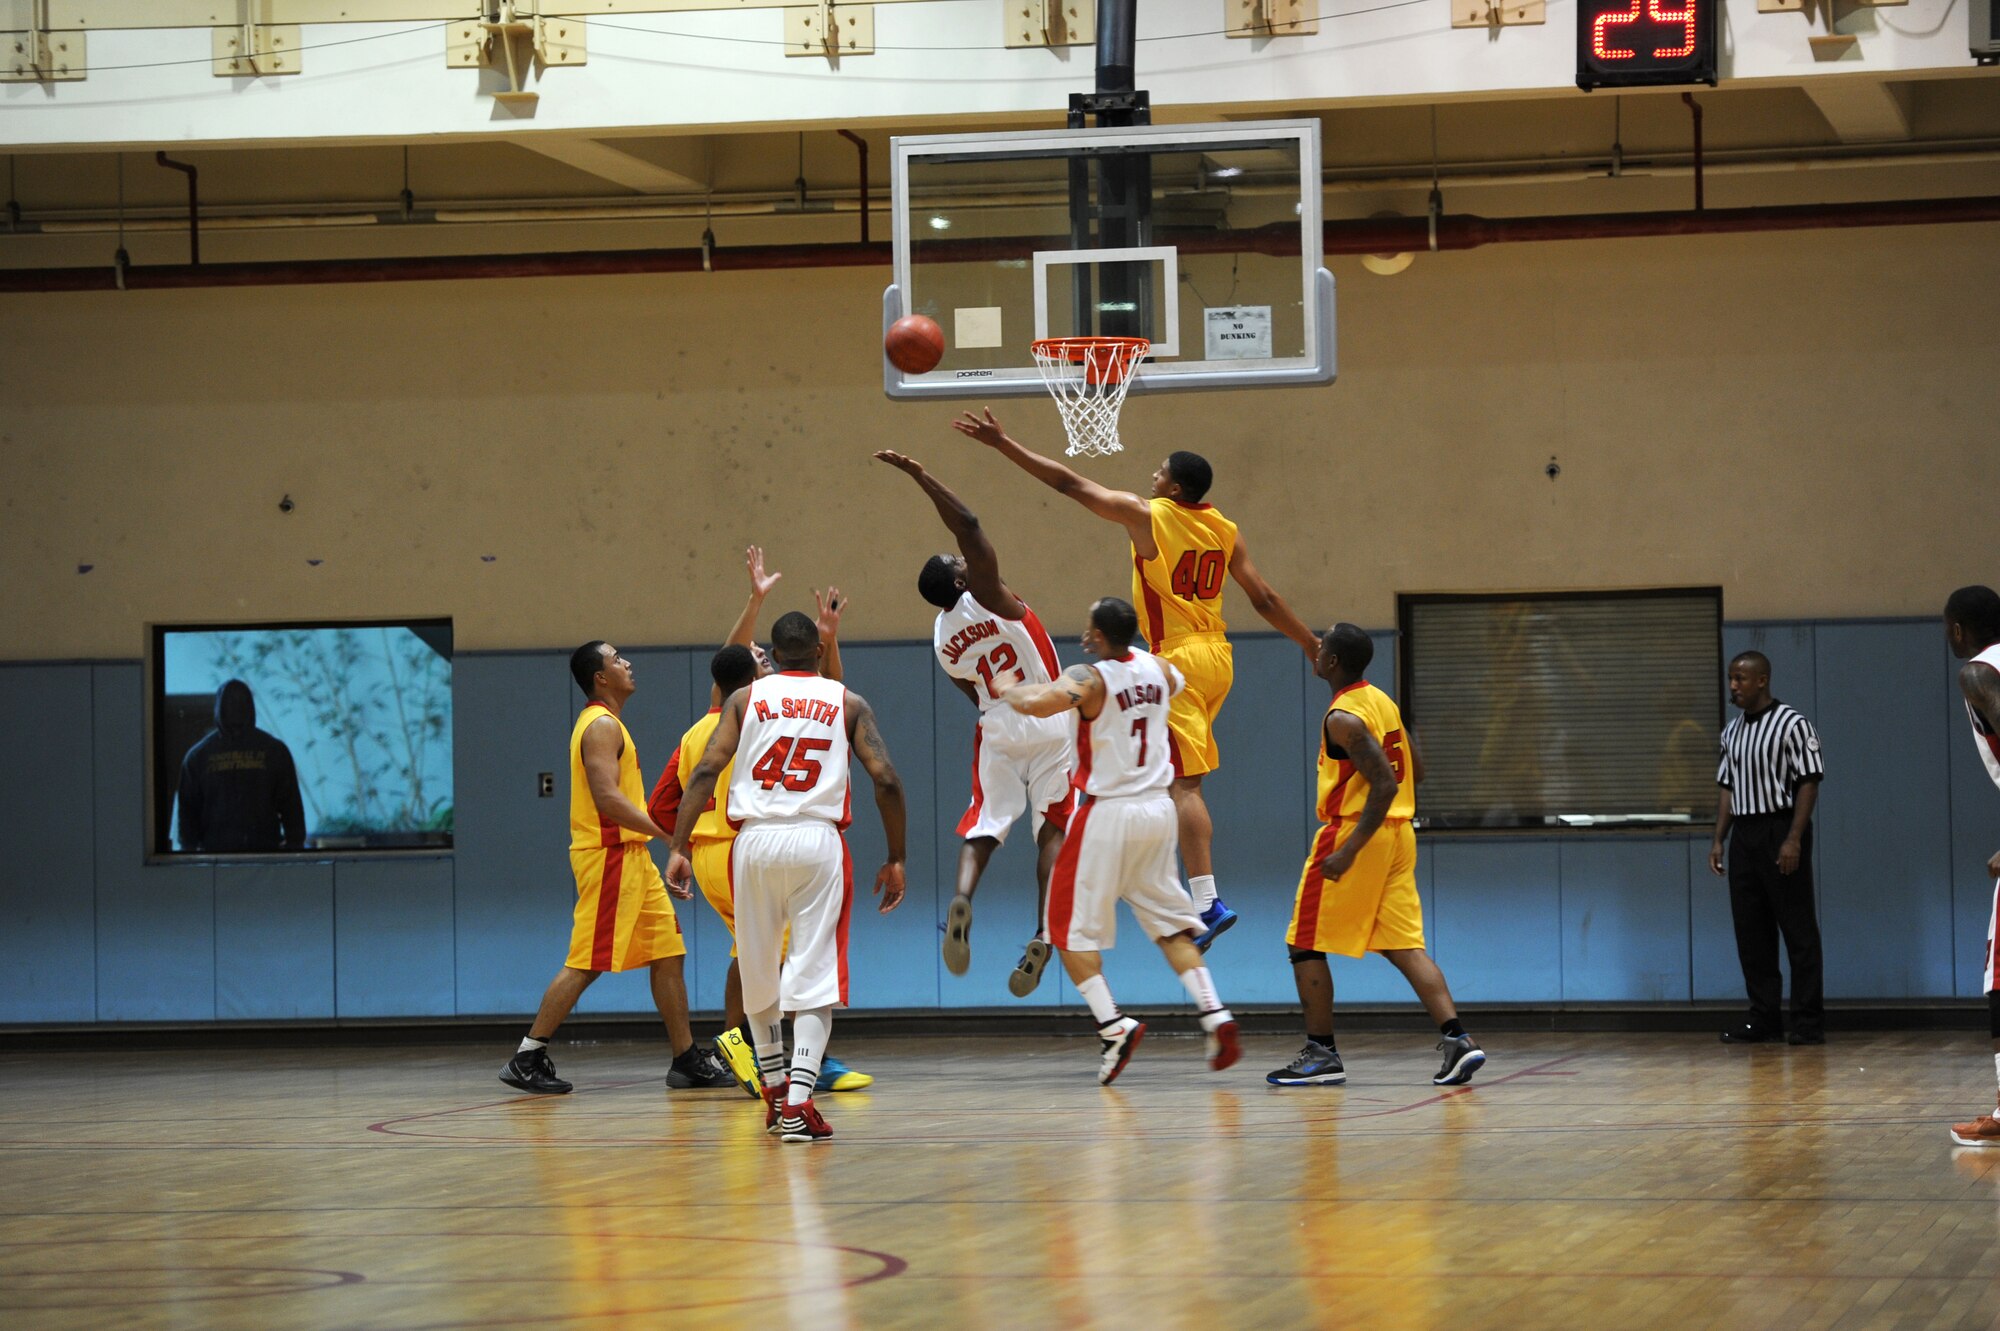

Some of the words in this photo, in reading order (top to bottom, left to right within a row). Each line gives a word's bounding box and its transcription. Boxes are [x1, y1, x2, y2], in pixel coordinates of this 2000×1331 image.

[1593, 0, 1696, 59] 29
[1220, 332, 1256, 340] DUNKING
[1171, 549, 1226, 602] 40
[941, 618, 1000, 665] JACKSON
[975, 641, 1026, 699] 12
[753, 699, 779, 723] M.
[781, 697, 840, 727] SMITH
[751, 735, 833, 793] 45
[1130, 716, 1149, 768] 7
